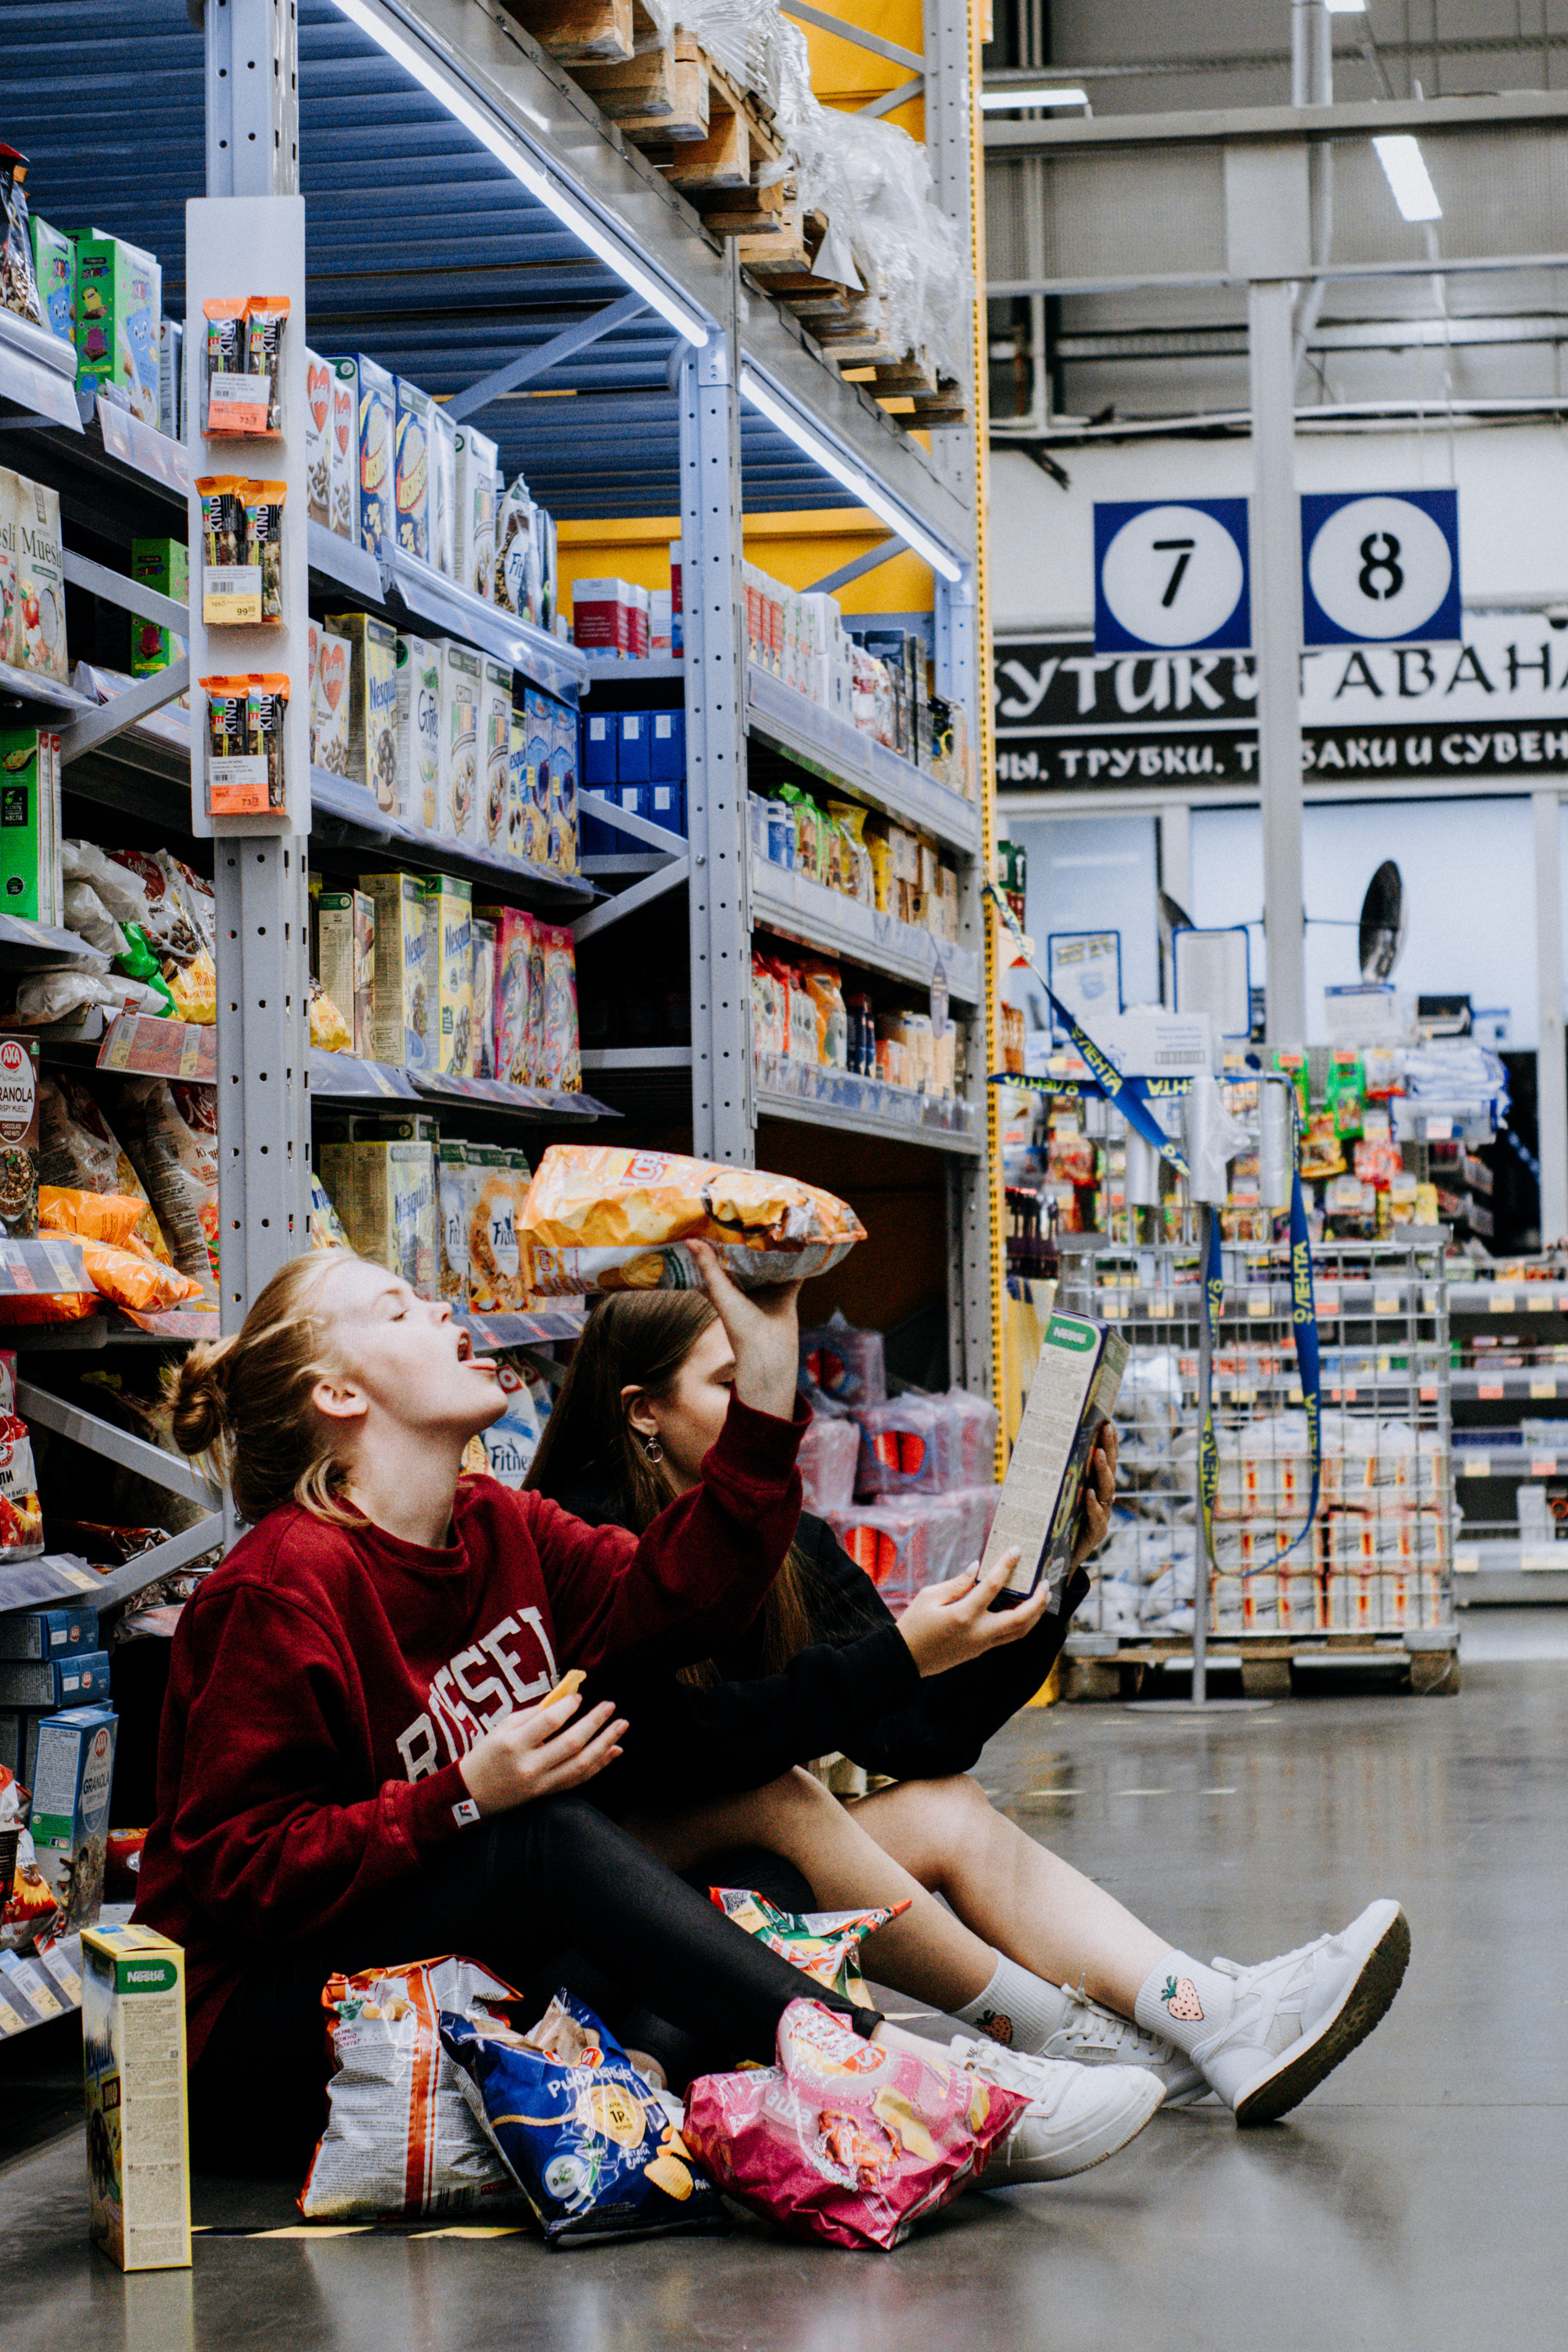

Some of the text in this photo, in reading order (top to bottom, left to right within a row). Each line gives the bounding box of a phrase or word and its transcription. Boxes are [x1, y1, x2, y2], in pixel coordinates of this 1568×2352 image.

[210, 496, 222, 532] KIND
[257, 505, 269, 541] KIND
[0, 522, 15, 552] sli
[1153, 539, 1195, 607] 7
[1359, 532, 1404, 600] 8
[992, 657, 1225, 718] УТИК
[1299, 643, 1568, 699] ГАВАН
[225, 697, 237, 734] KIND
[260, 694, 272, 730] KIND
[1235, 737, 1397, 772] ТБАКИ
[1404, 737, 1433, 766] И
[3, 1046, 21, 1064] AXA
[1079, 1039, 1123, 1097] ЛЕНТА
[1293, 1240, 1311, 1309] ЛЕНТА
[83, 1771, 110, 1795] GRANOLA
